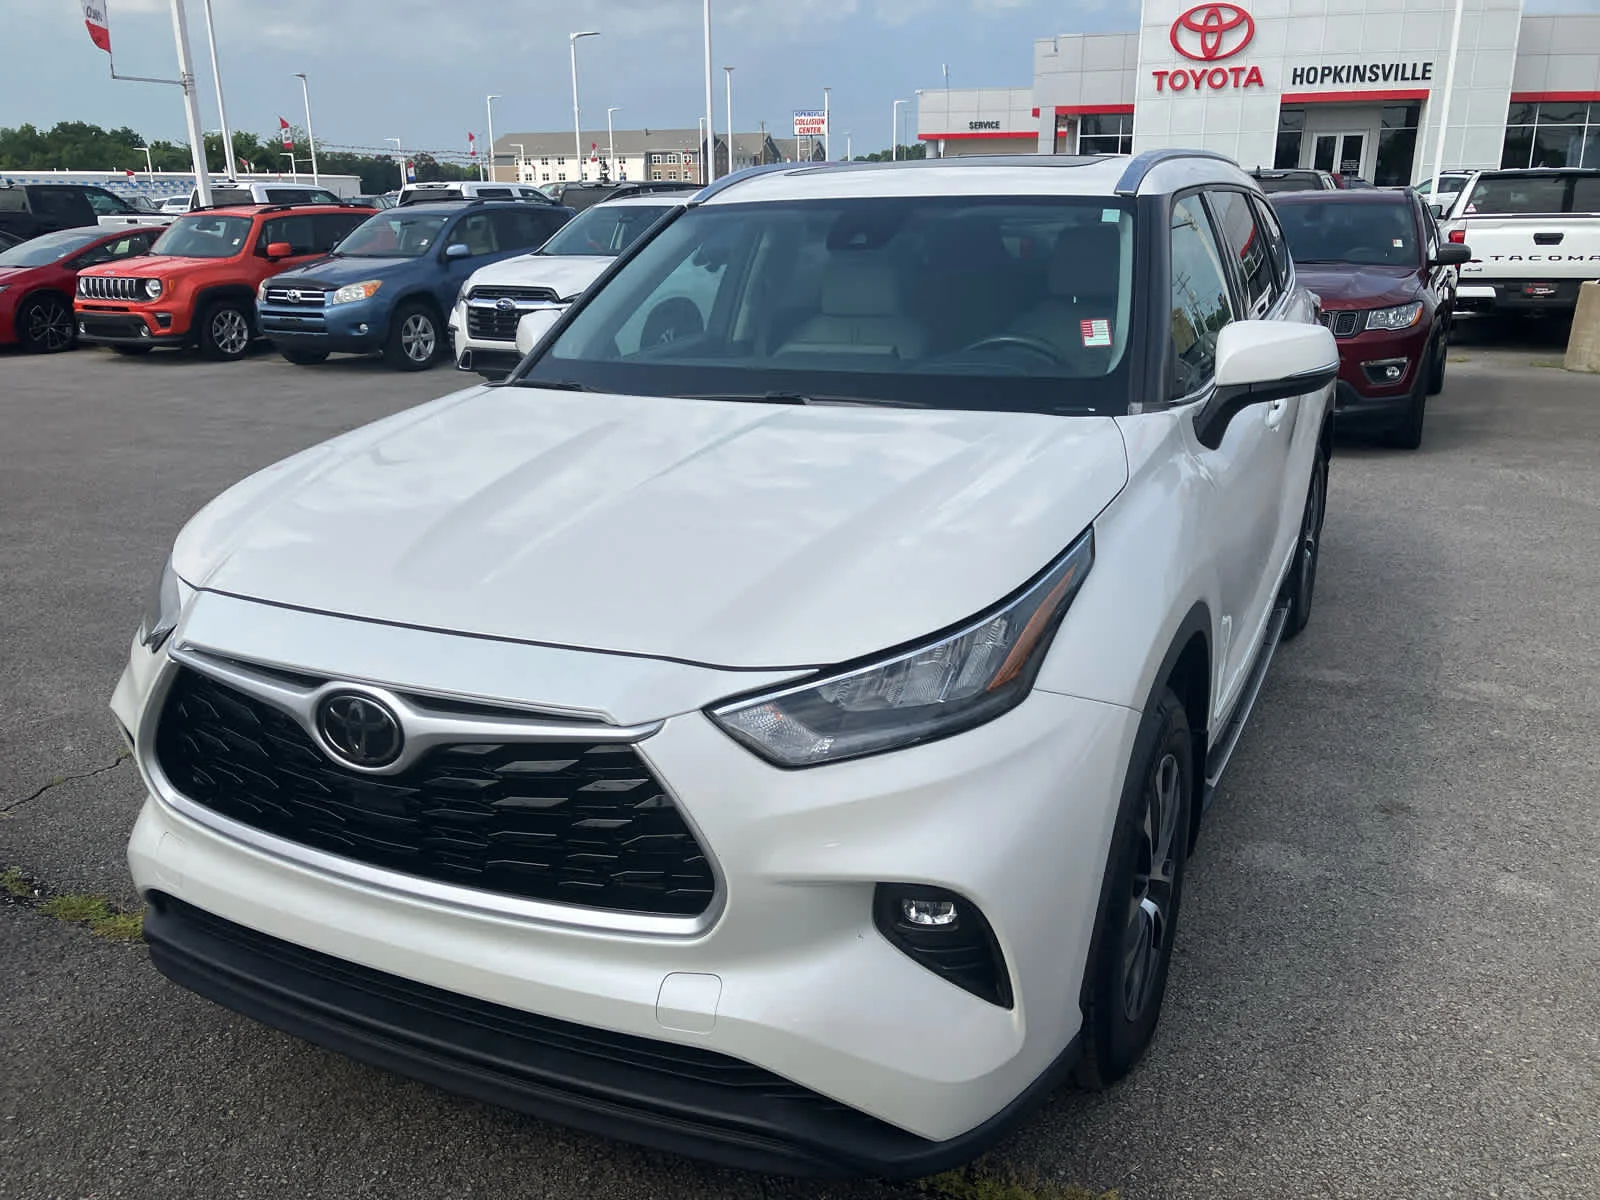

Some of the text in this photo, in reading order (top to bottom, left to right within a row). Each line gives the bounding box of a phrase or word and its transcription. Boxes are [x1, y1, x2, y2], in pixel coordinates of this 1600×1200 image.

[1292, 62, 1432, 85] HOPKINSVILLE
[1152, 66, 1264, 91] TOYOTA
[795, 118, 825, 126] COLLISION
[969, 121, 1000, 129] SERVICE
[798, 126, 821, 134] CENTER
